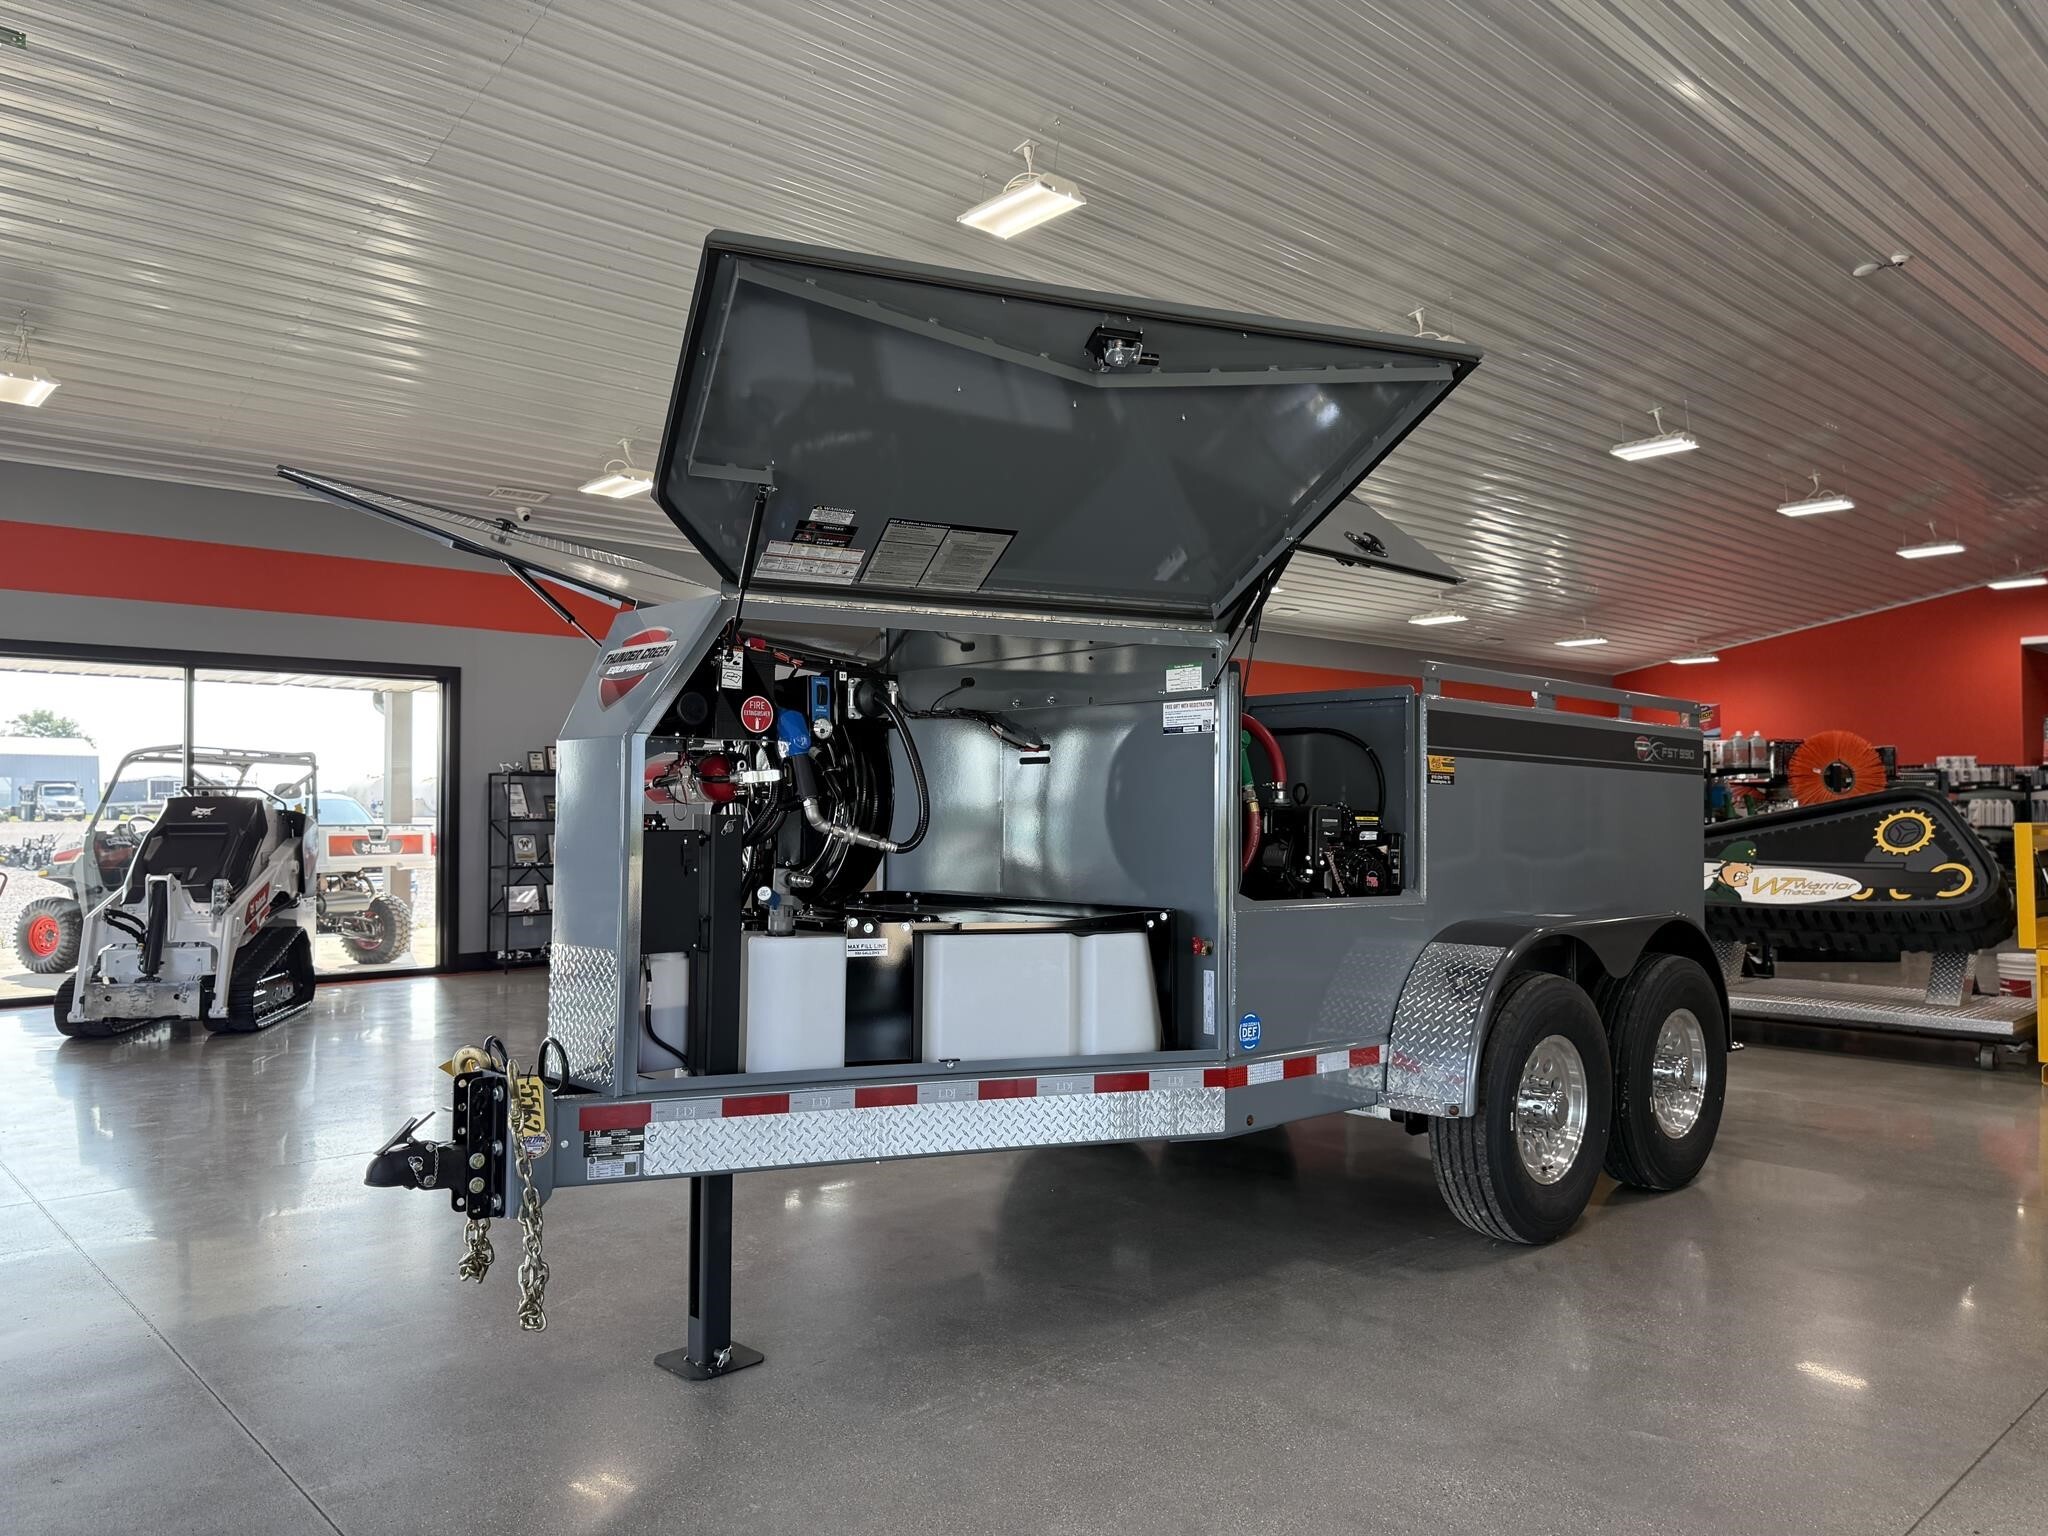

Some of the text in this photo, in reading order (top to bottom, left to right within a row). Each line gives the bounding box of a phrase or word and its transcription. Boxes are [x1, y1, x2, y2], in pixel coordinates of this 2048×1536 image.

[603, 644, 674, 665] THUNDER CREEK
[606, 661, 653, 675] EQUIPMENT
[749, 700, 765, 710] FIRE
[743, 709, 771, 717] EXTINGUISHER
[1661, 747, 1679, 759] FST
[1794, 879, 1858, 891] Warrior
[1783, 888, 1828, 896] Tracks
[1242, 1026, 1258, 1038] DEF
